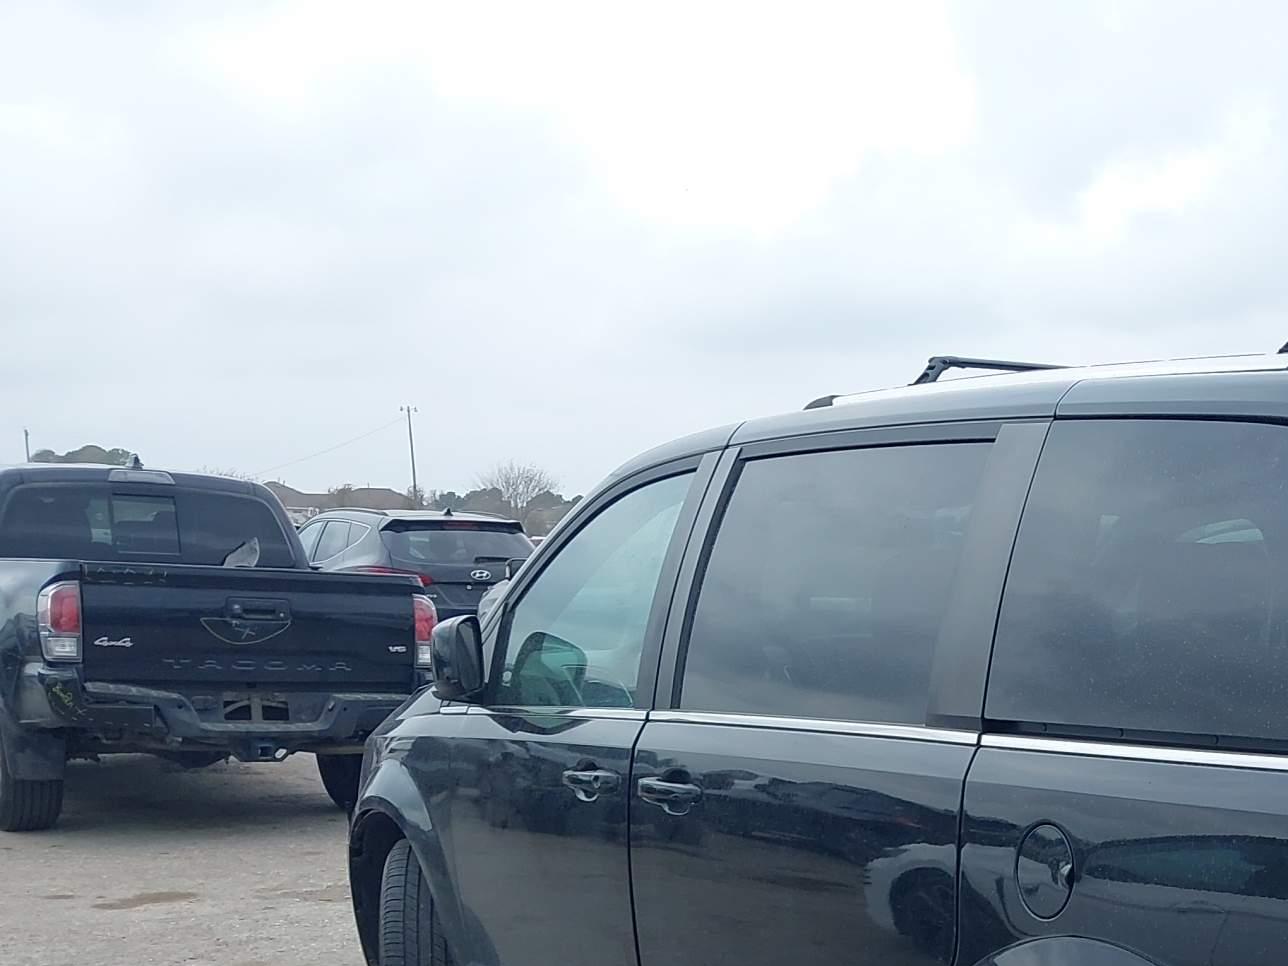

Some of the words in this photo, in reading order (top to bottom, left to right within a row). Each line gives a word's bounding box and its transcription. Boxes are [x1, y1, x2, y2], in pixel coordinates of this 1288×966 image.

[93, 636, 134, 648] 4x4
[388, 645, 407, 653] V6
[162, 658, 352, 671] TACOMA
